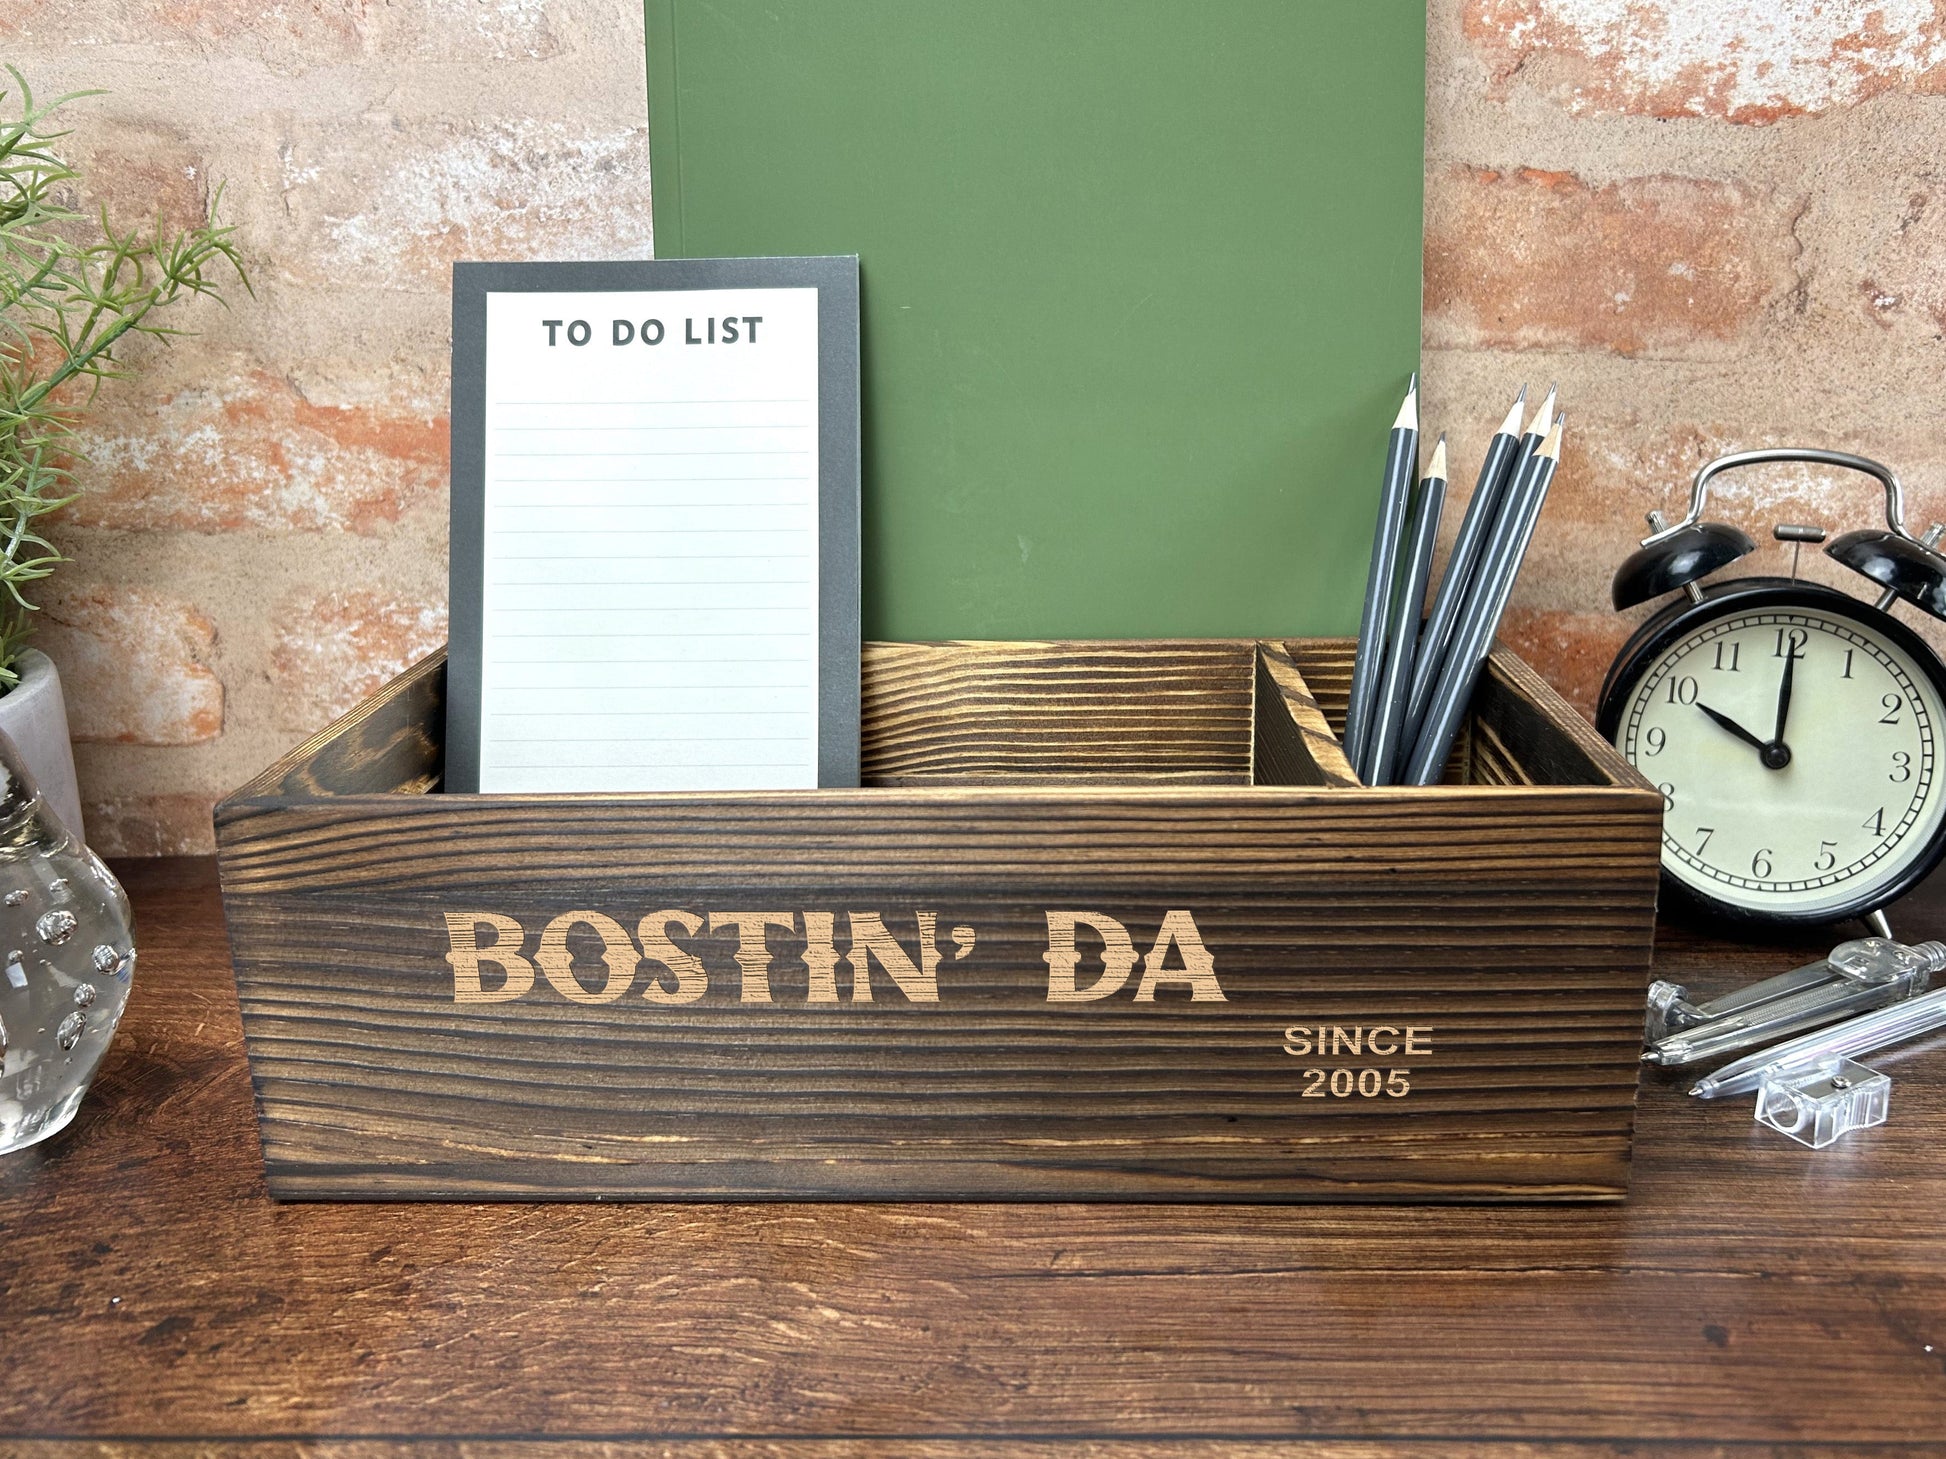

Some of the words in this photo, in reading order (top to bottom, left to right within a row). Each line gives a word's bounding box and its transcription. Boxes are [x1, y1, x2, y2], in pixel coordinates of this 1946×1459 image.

[542, 319, 592, 347] TO
[612, 318, 665, 346] DO
[685, 316, 763, 344] LIST
[1712, 641, 1741, 672] 11
[1771, 627, 1809, 659] 12
[1840, 649, 1854, 679] 1
[1665, 676, 1698, 705] 10
[1878, 693, 1903, 724] 2
[1644, 727, 1666, 756] 9
[1888, 751, 1911, 783] 3
[1862, 807, 1886, 837] 4
[1695, 827, 1714, 856] 7
[1814, 841, 1838, 871] 5
[1751, 848, 1773, 878] 6
[443, 910, 977, 1003] BOSTIN'
[1042, 910, 1229, 1002] DA
[1282, 1025, 1434, 1056] SINCE
[1301, 1068, 1411, 1098] 2005
